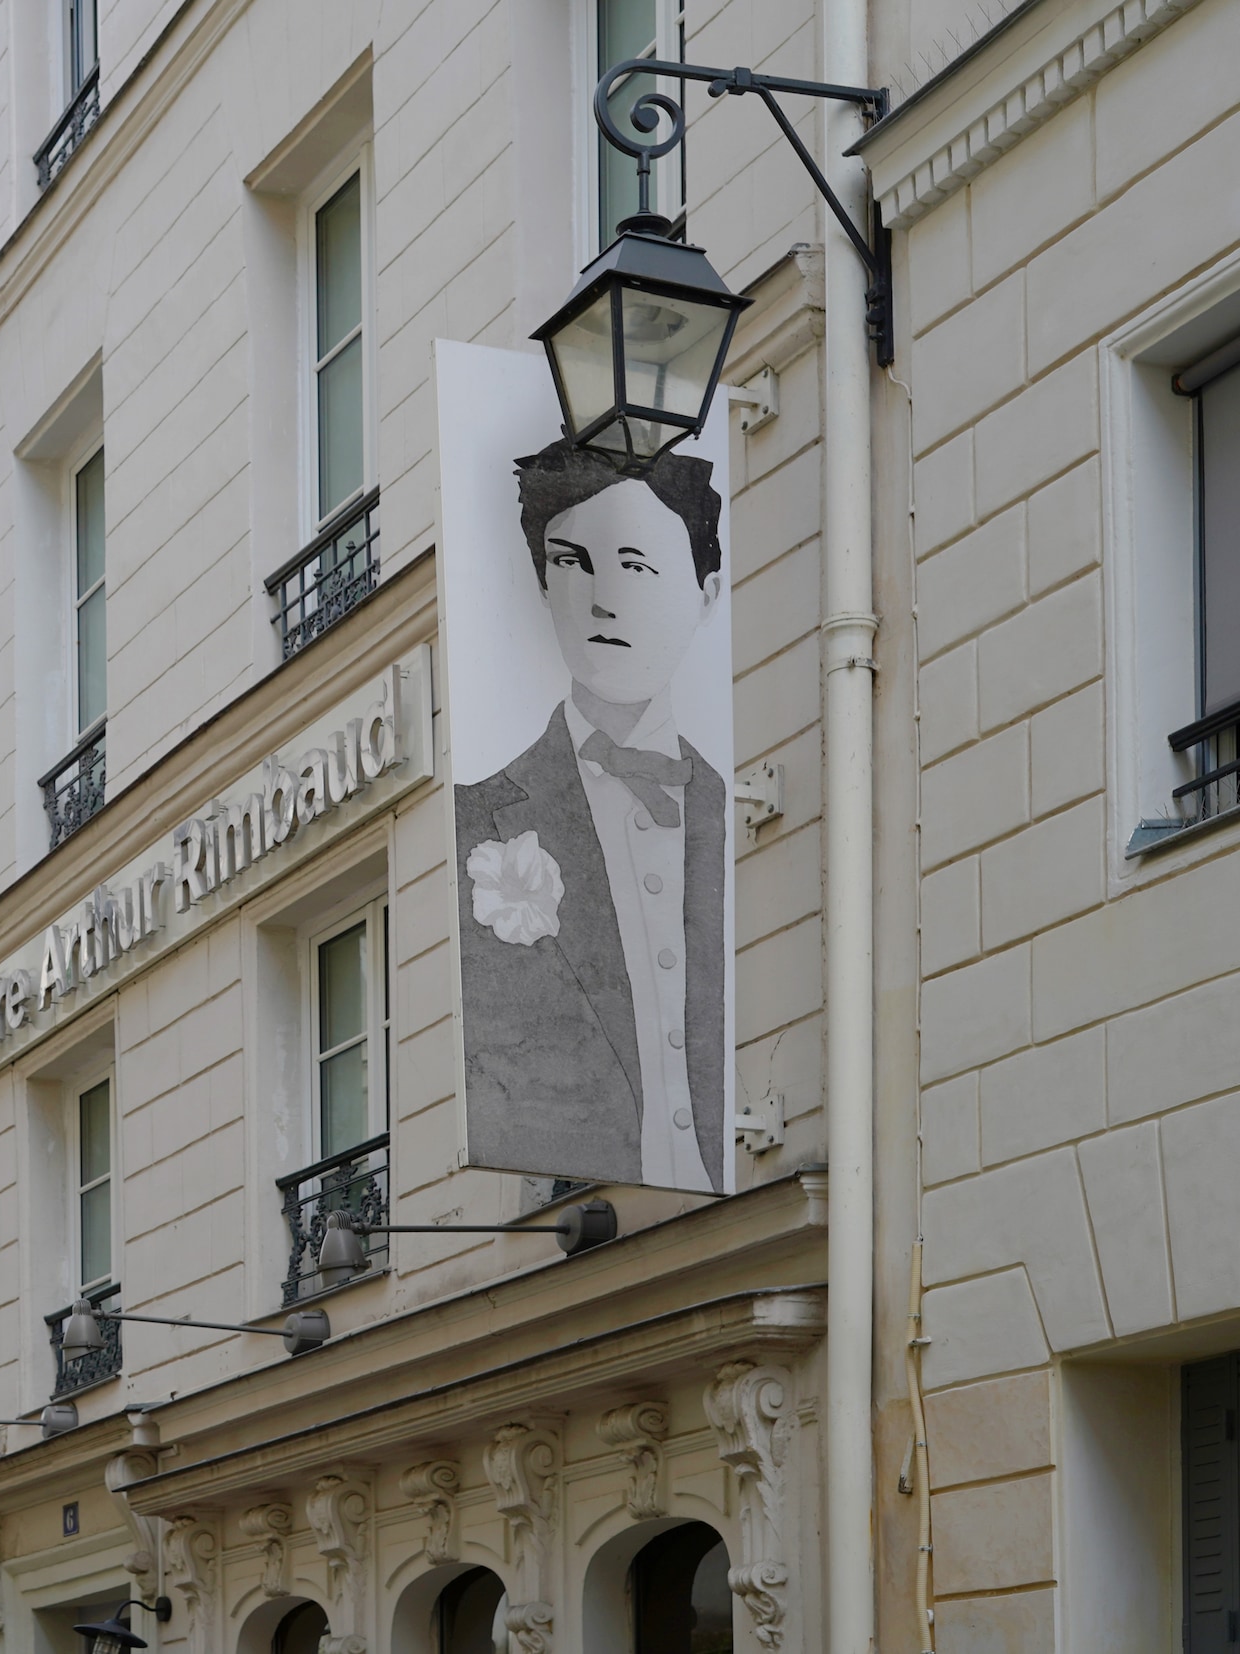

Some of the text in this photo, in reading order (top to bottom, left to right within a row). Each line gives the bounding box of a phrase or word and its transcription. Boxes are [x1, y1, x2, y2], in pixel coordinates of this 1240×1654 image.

[38, 861, 165, 1013] Arthur
[173, 664, 403, 914] Rimbaud
[66, 1508, 74, 1531] 6
